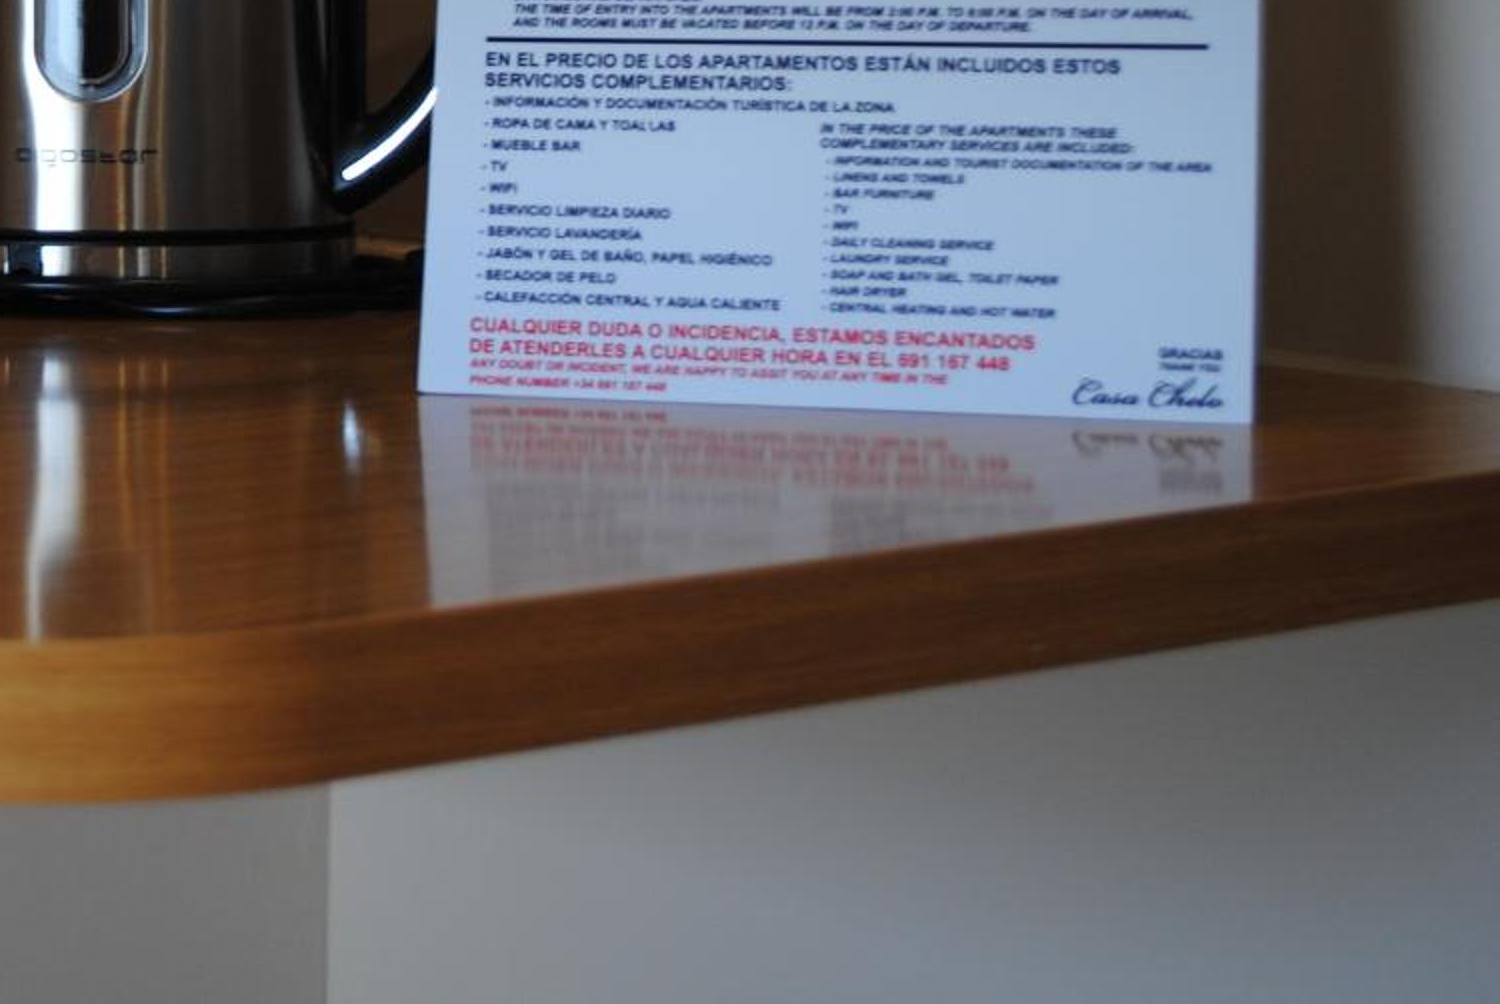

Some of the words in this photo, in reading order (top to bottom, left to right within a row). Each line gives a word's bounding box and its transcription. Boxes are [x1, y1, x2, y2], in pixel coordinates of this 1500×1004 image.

[485, 51, 510, 67] EN
[515, 51, 539, 67] EL
[544, 52, 617, 68] PRECIO
[622, 53, 648, 69] DE
[654, 53, 693, 69] LOS
[697, 54, 858, 71] APARTAMENTOS
[864, 54, 930, 71] ESTÁN
[936, 56, 1047, 74] INCLUIDOS
[1051, 57, 1120, 74] ESTOS
[484, 71, 586, 89] SERVICIOS
[490, 138, 547, 151] MUEBLE
[551, 140, 580, 151] BAR
[484, 268, 552, 282] SECADOR
[555, 270, 574, 283] DE
[578, 271, 616, 284] PELO
[470, 316, 581, 335] CUALQUIER
[587, 320, 643, 337] DUDA
[647, 323, 662, 338] O
[792, 327, 888, 345] ESTAMOS
[893, 330, 1035, 350] ENCANTADOS
[469, 337, 494, 354] DE
[499, 339, 626, 358] ATENDERLES
[631, 344, 644, 358] A
[650, 344, 765, 362] CUALQUIER
[771, 348, 828, 364] HORA
[833, 349, 861, 365] EN
[867, 351, 889, 367] EL
[1159, 347, 1223, 360] GRACIAS
[1071, 376, 1139, 406] Casa
[1147, 376, 1225, 409] Chelo
